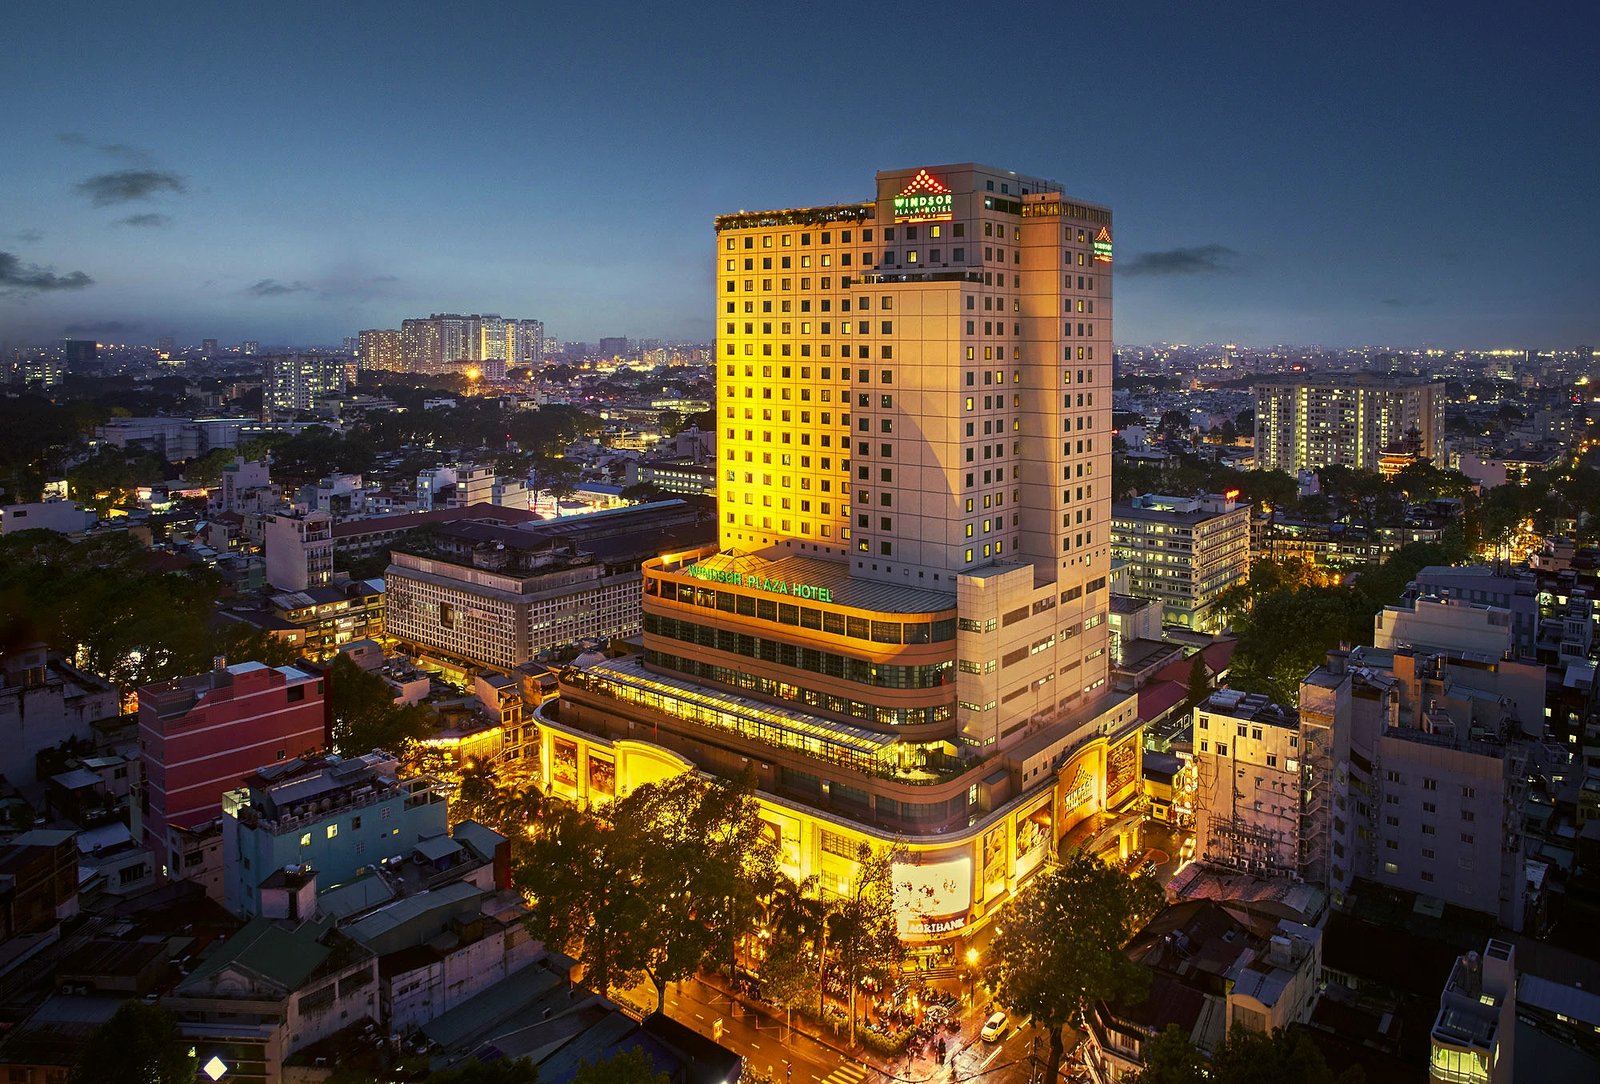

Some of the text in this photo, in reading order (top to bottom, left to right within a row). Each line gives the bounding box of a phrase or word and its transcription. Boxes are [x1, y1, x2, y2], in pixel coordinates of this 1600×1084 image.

[894, 194, 952, 208] WINDSOR
[925, 205, 952, 214] HOTEL
[688, 564, 833, 603] WINDSOR PLAZA HOTEL
